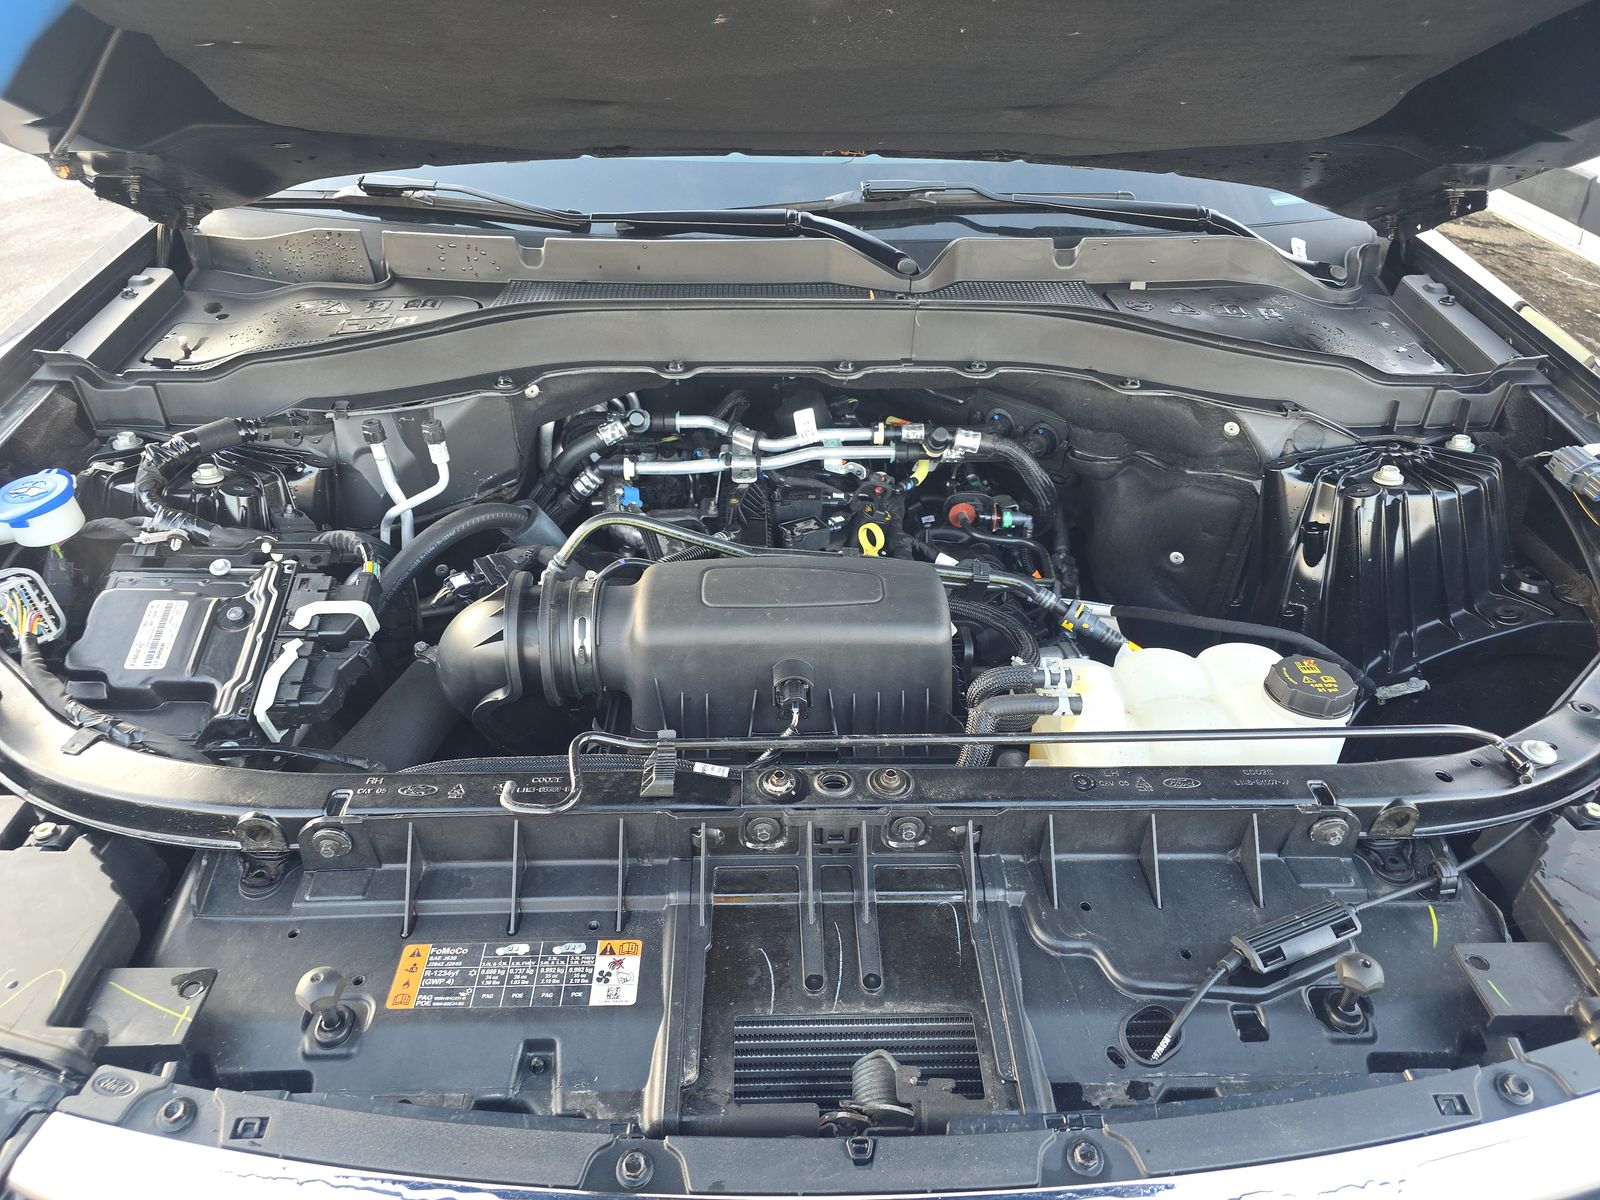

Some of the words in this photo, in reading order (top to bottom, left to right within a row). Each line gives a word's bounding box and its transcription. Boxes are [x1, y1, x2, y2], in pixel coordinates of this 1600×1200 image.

[366, 777, 384, 785] RH
[1164, 778, 1200, 788] Ford
[430, 947, 469, 955] FoMoCo
[424, 969, 459, 978] R-1234yf
[497, 968, 506, 976] kg
[525, 967, 534, 975] kg
[557, 967, 565, 975] kg
[586, 966, 593, 974] kg
[422, 978, 445, 986] (GWP
[446, 978, 455, 986] 4)
